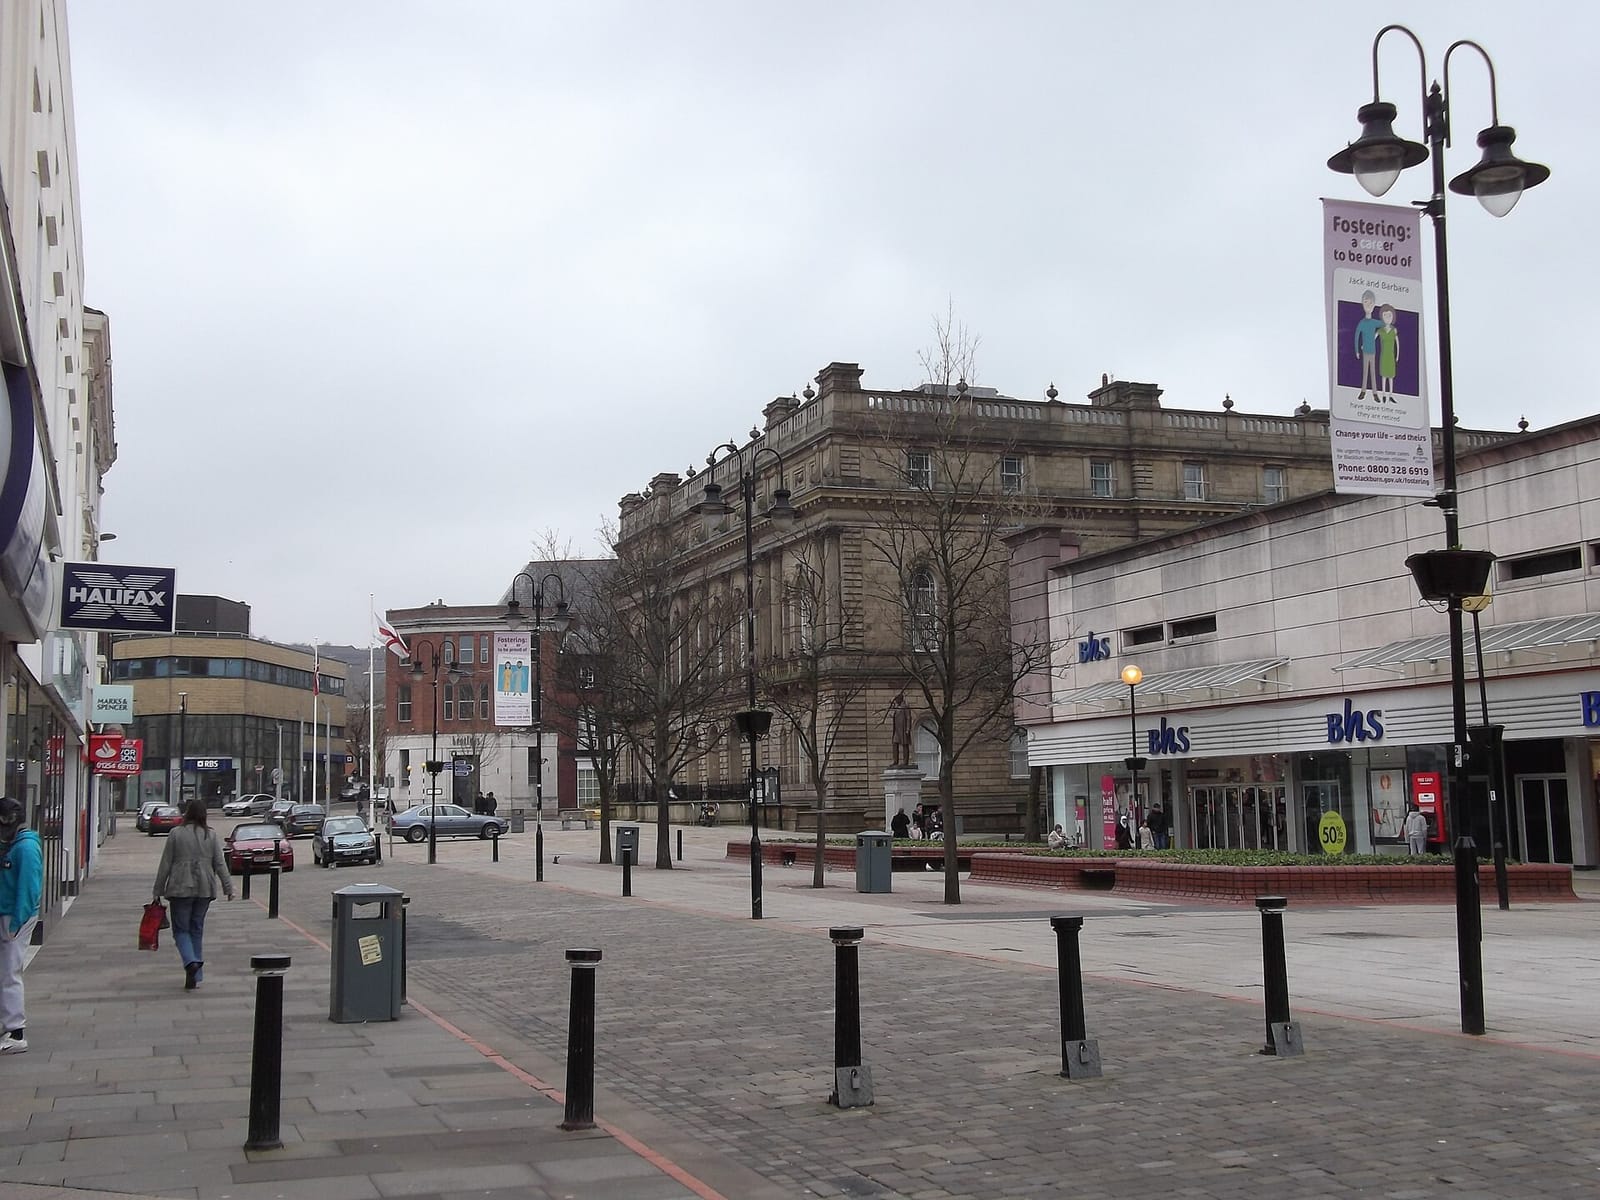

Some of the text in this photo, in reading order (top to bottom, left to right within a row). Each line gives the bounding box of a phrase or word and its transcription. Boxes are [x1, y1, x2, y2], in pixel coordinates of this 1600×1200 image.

[1333, 216, 1411, 242] Fostering:
[1351, 238, 1394, 251] a career
[1334, 249, 1412, 267] to be proud of
[1349, 277, 1409, 293] Jack and Barbara
[1335, 429, 1360, 440] Change
[1361, 431, 1376, 440] your
[1377, 431, 1388, 439] life
[1338, 464, 1429, 476] Phone: 0800 328 6919
[1339, 476, 1430, 485] www.blackburn.gov.uk/fostering
[69, 587, 166, 607] HALIFAX
[1078, 631, 1110, 663] Bhs
[1326, 698, 1385, 745] Bhs
[1148, 717, 1191, 755] Bhs
[204, 760, 219, 768] RBS
